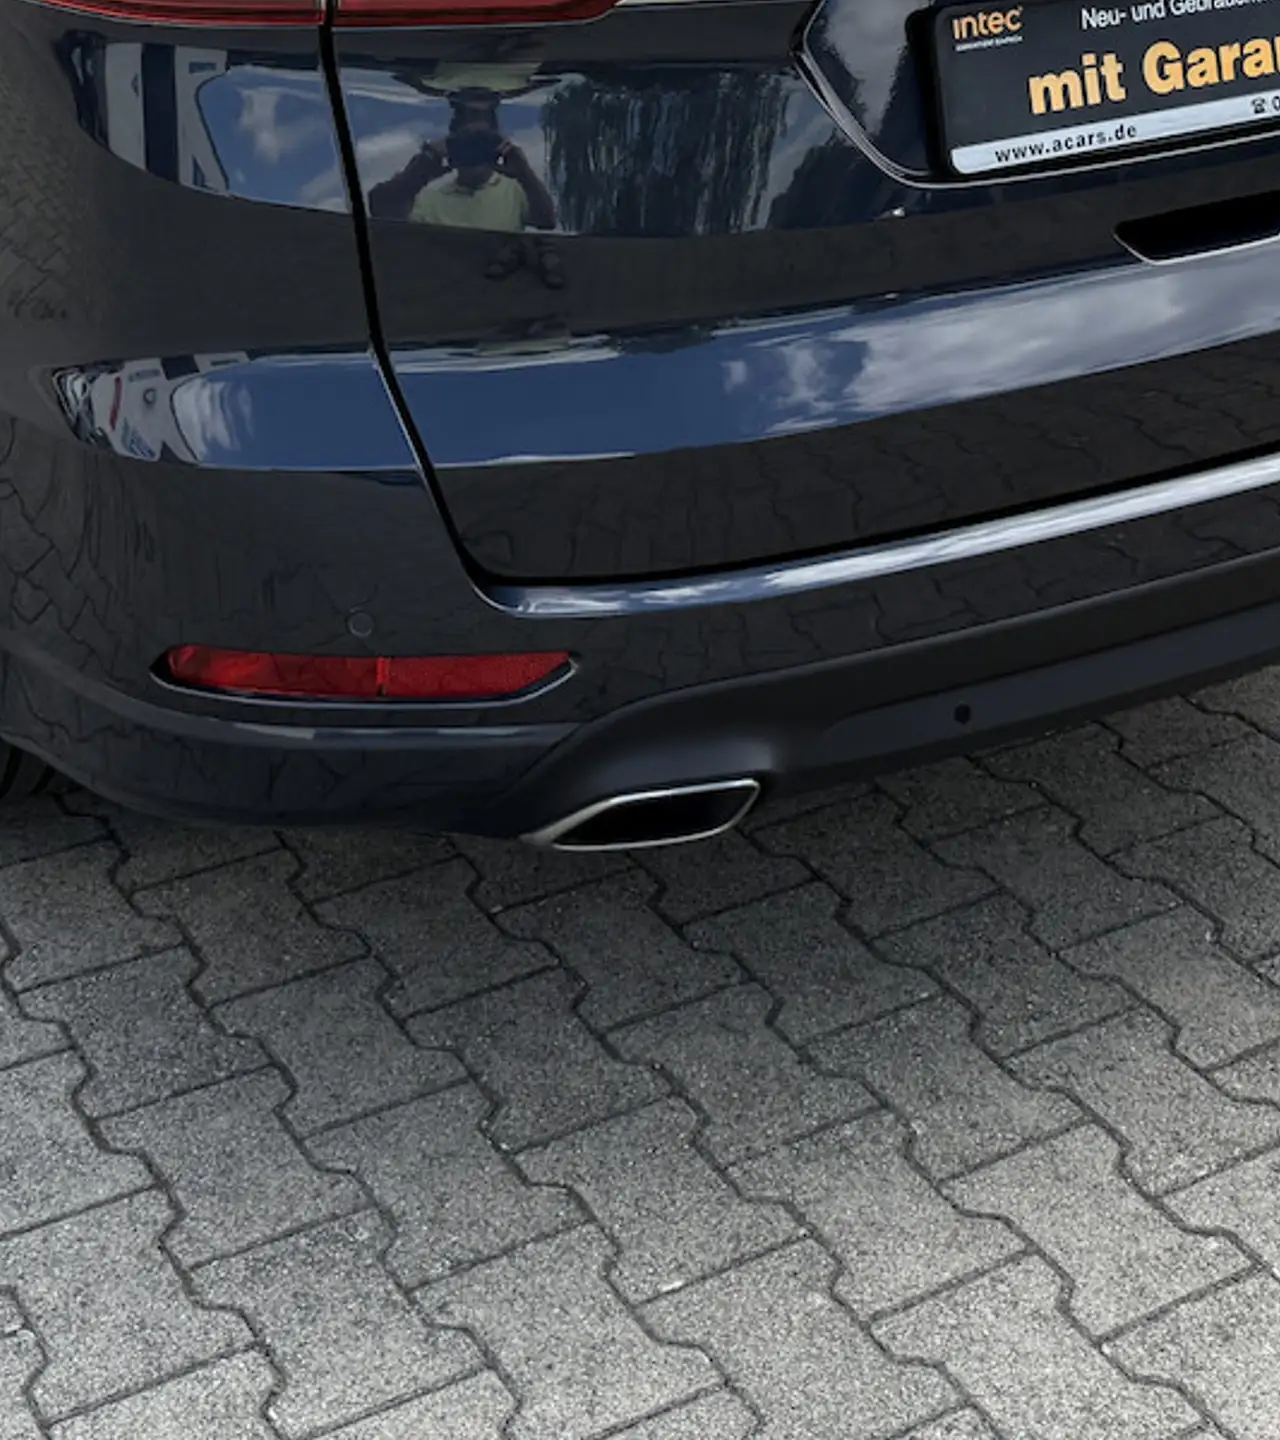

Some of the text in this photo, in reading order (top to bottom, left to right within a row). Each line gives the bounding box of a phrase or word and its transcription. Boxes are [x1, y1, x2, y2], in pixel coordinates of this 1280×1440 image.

[1081, 4, 1127, 30] Neu-
[1028, 53, 1127, 114] mit
[994, 124, 1138, 163] www.acars.de
